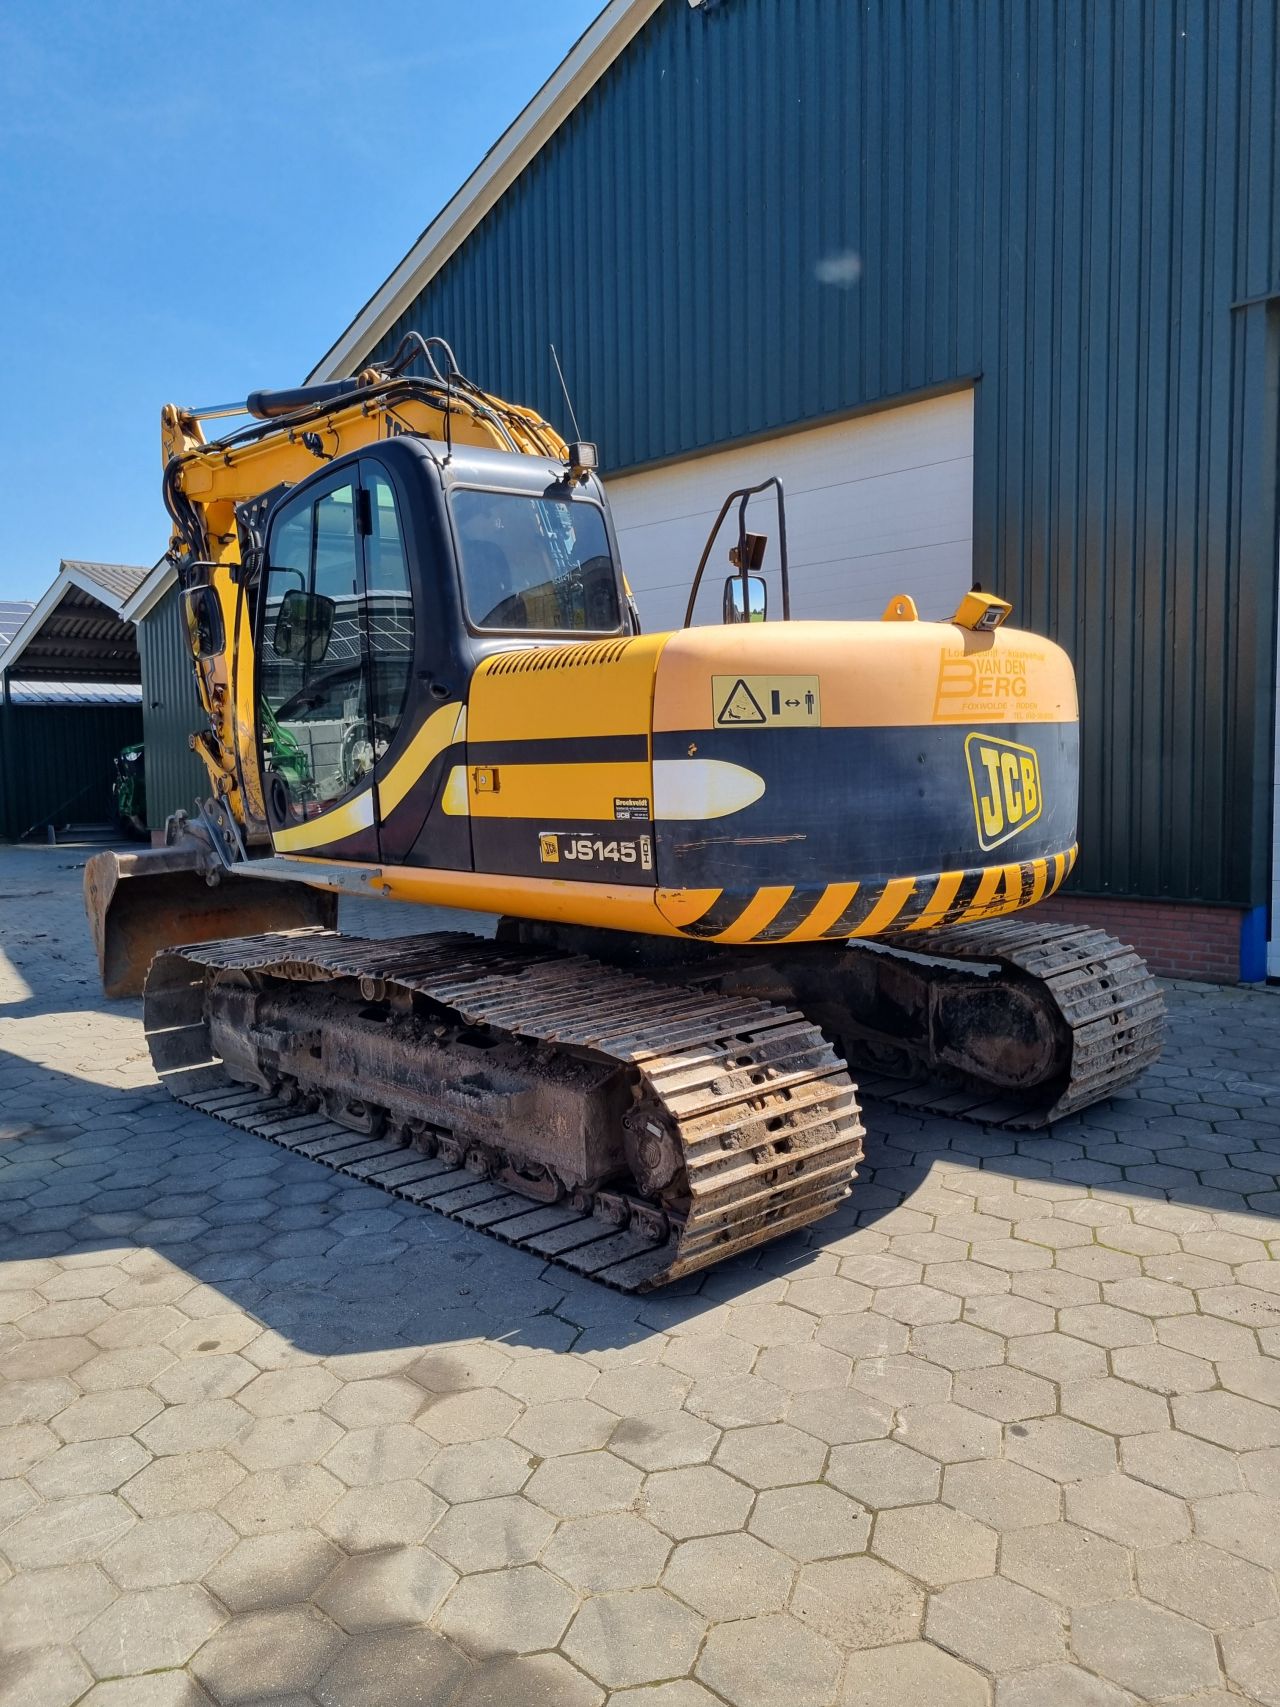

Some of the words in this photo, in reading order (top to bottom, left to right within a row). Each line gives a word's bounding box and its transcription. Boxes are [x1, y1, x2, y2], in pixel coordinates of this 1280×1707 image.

[976, 659, 1001, 675] VAN
[1005, 659, 1026, 675] DEN
[934, 658, 1027, 700] BERG
[961, 702, 1008, 711] FOXWOLDE
[980, 746, 1037, 837] JCB
[564, 840, 637, 863] JS145
